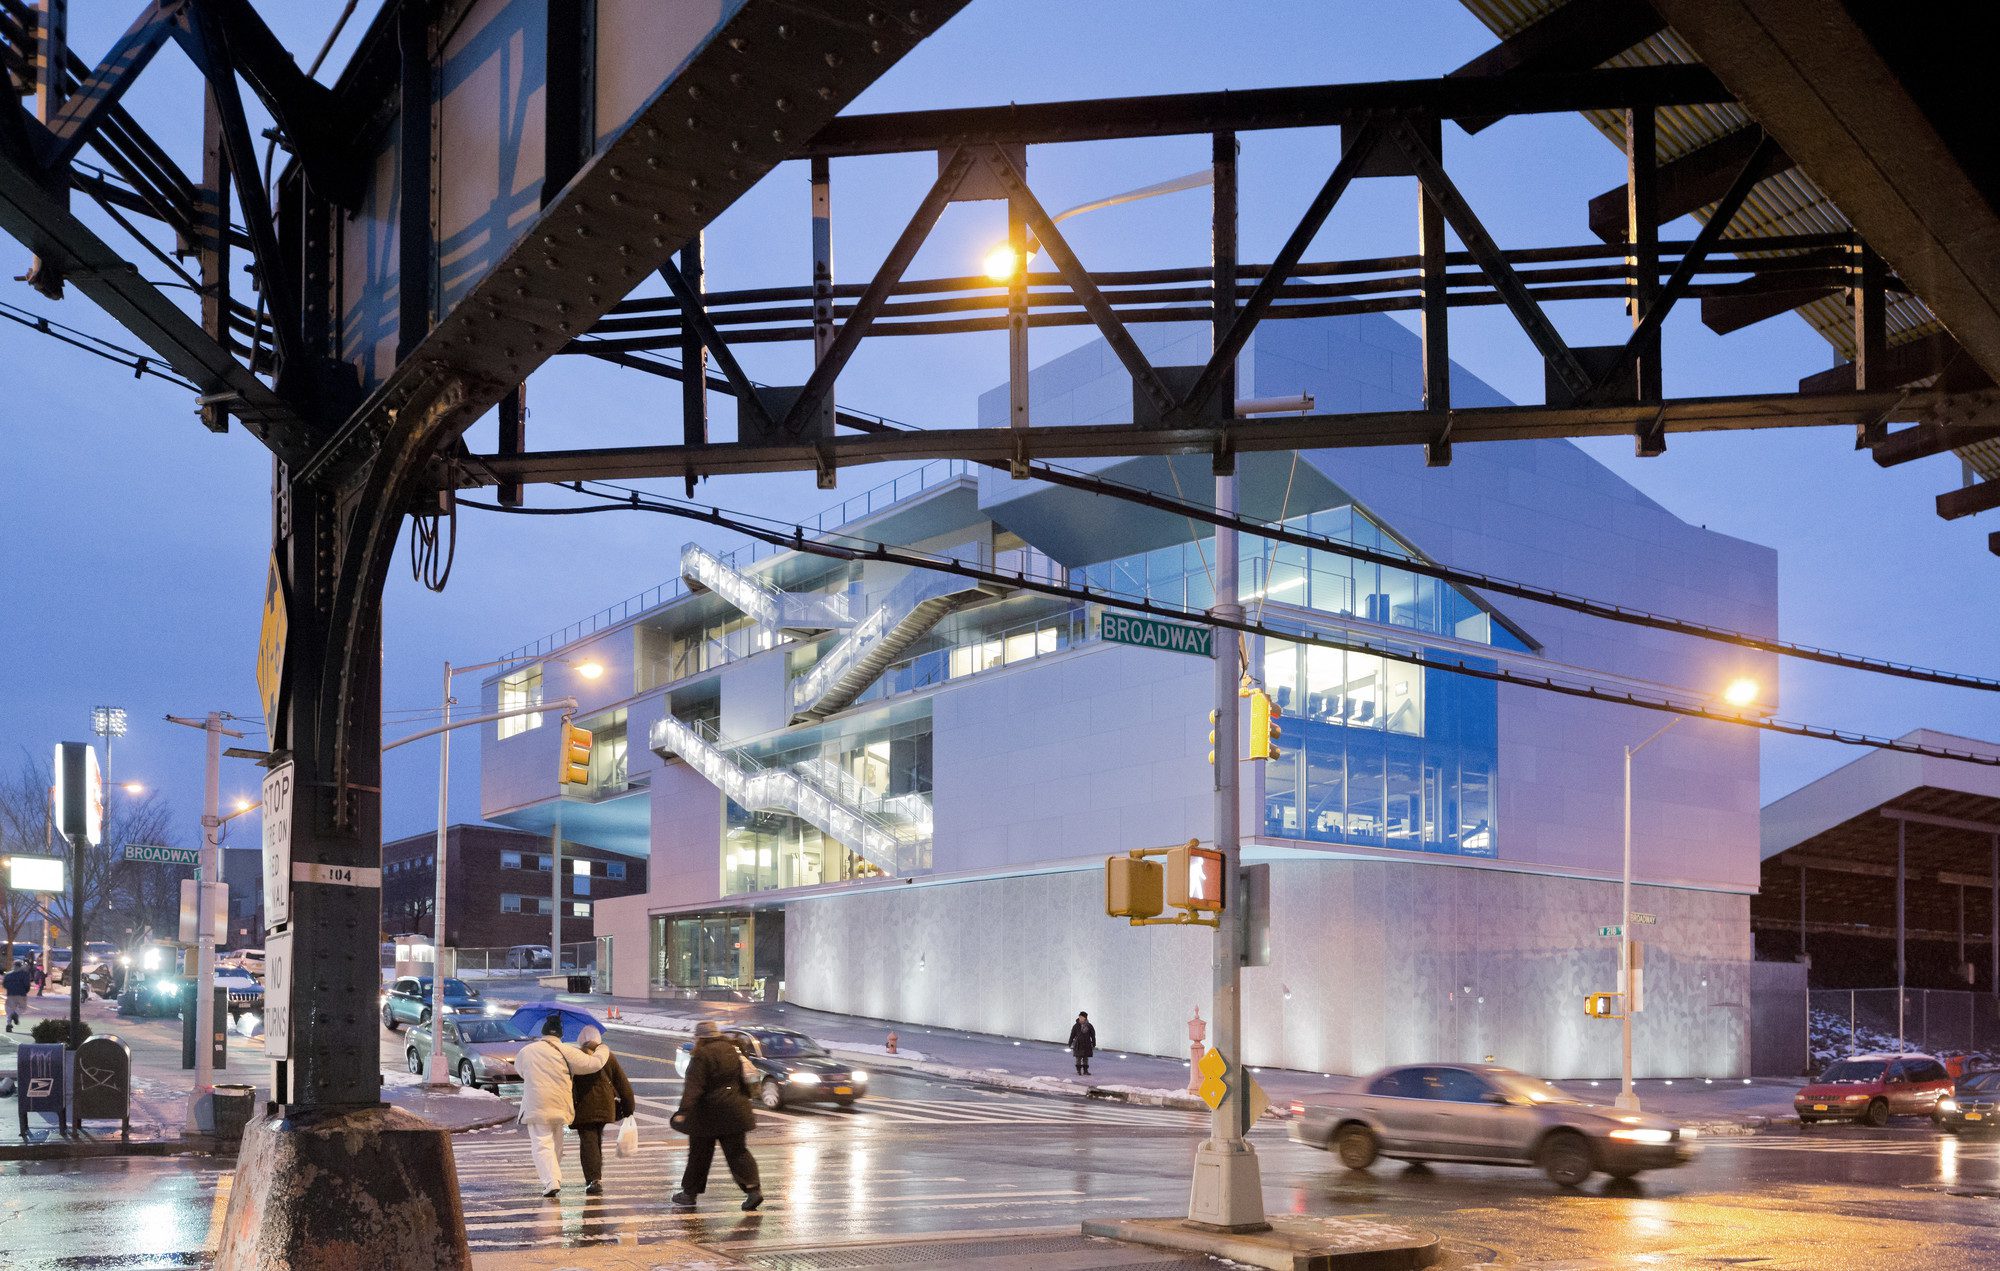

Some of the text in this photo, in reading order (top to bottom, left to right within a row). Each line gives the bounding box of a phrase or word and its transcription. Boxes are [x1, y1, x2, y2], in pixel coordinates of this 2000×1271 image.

[1103, 616, 1210, 653] BROADWAY
[263, 776, 289, 819] STOP
[278, 819, 288, 842] ON
[125, 846, 198, 863] BROADWAY
[329, 868, 351, 882] 104
[1630, 913, 1655, 924] BROADWAY
[271, 956, 282, 989] NO
[265, 1005, 286, 1037] TURNS
